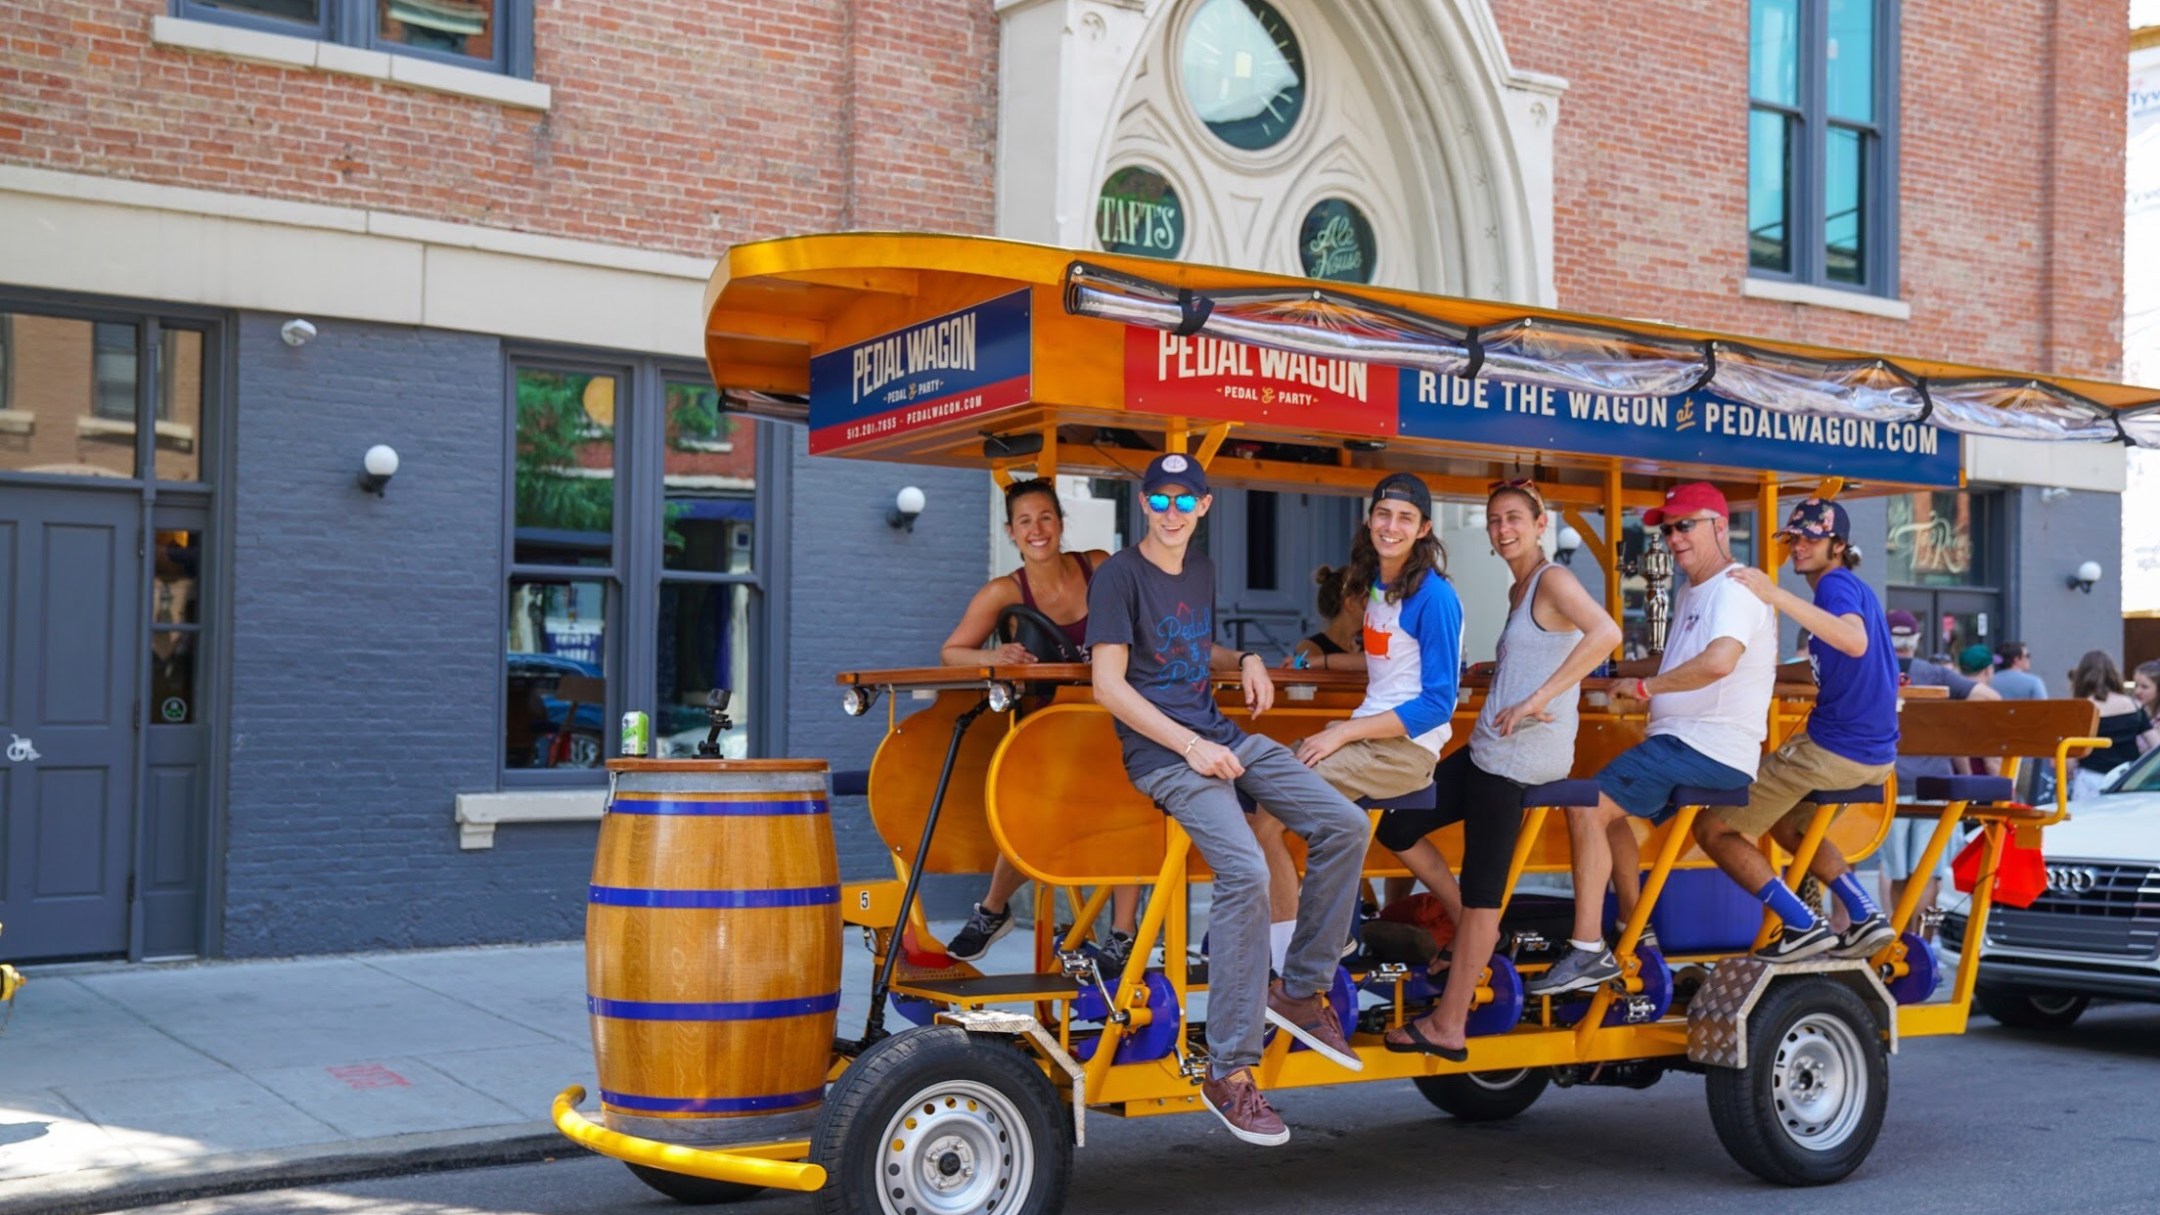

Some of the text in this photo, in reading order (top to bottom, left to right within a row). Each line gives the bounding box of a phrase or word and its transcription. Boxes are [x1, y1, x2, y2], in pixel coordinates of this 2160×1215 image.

[1099, 196, 1176, 250] TAFT'S
[1310, 214, 1355, 252] Ale
[1310, 246, 1363, 279] House
[853, 312, 976, 405] PEDAL WAGON
[1158, 329, 1368, 403] PEDAL WAGON
[887, 388, 907, 404] PEDAL
[918, 379, 940, 395] PARTY
[1224, 385, 1312, 406] PEDAL & PARTY
[906, 395, 983, 425] PEDALWAGON.COM
[1418, 370, 1938, 455] RIDE THE WAGON at PEDALWAGON.COM
[861, 891, 869, 909] 5
